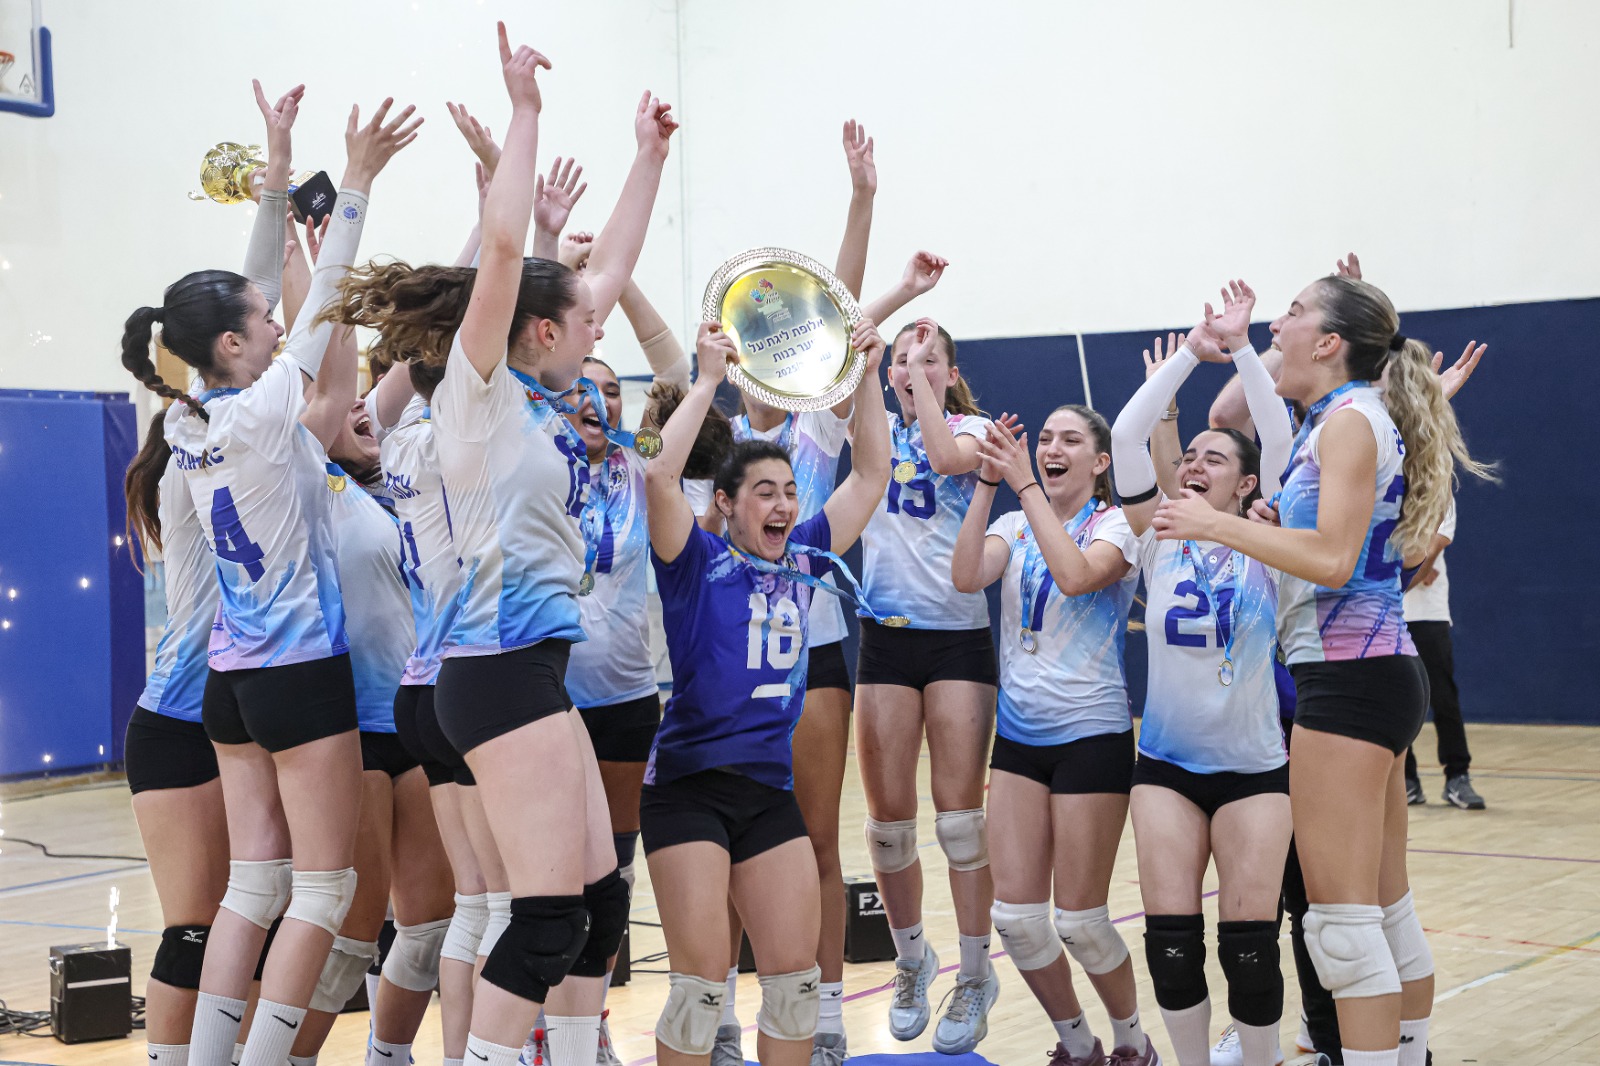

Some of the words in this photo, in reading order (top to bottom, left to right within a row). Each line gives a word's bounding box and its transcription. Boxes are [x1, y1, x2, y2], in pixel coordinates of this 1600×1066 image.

[747, 342, 764, 353] על
[766, 330, 789, 347] ליגת
[792, 318, 825, 337] אלופת
[773, 347, 796, 363] בנות
[886, 457, 937, 520] 15
[210, 485, 266, 583] 4
[746, 592, 803, 670] 18
[1164, 579, 1236, 649] 21
